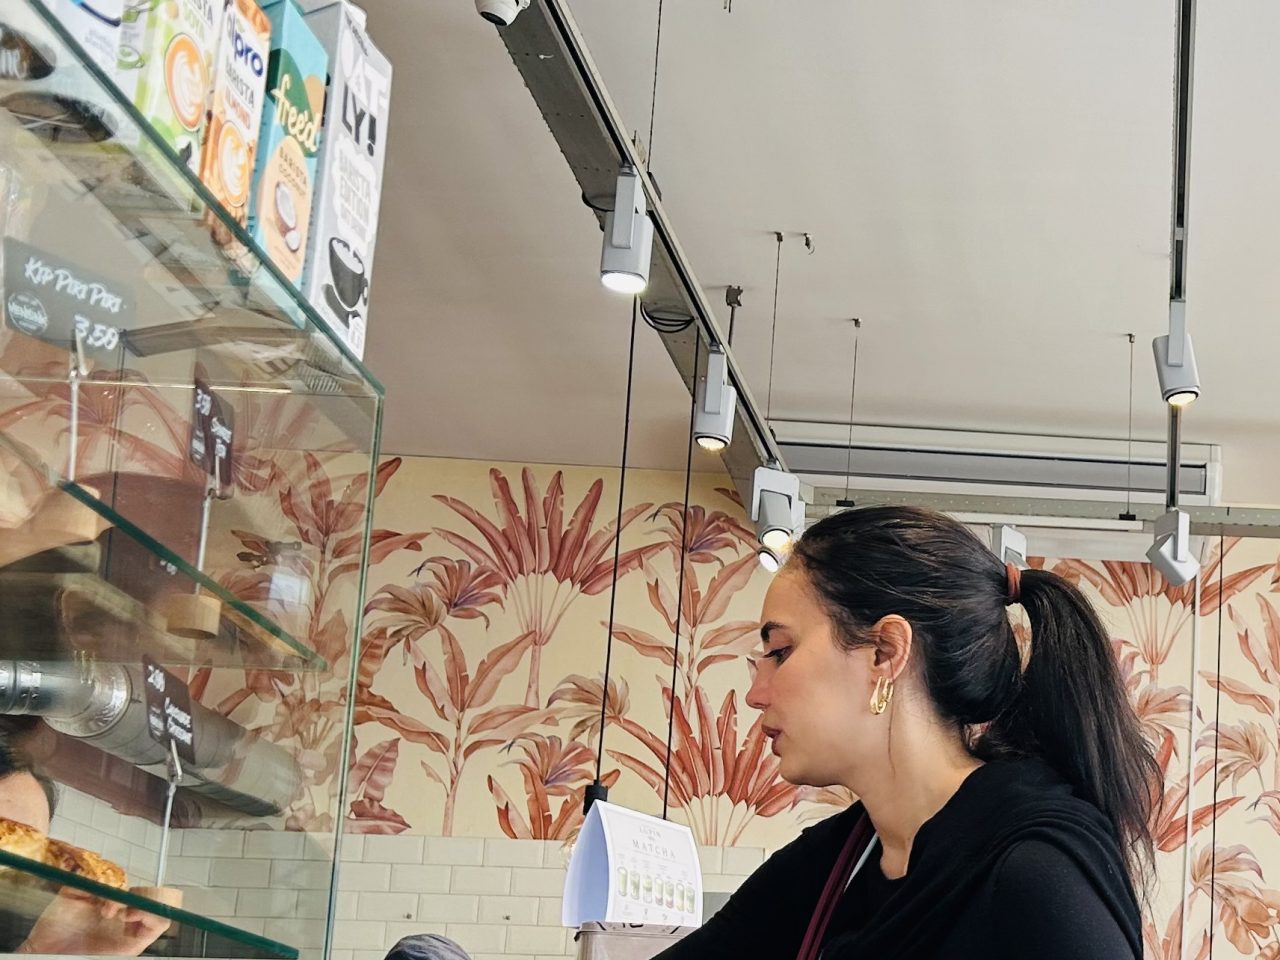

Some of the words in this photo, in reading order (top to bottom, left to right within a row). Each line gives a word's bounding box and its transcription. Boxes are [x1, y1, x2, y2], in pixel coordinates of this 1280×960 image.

[225, 10, 264, 77] alpro
[341, 82, 377, 157] LY!
[632, 838, 677, 860] MATCHA
